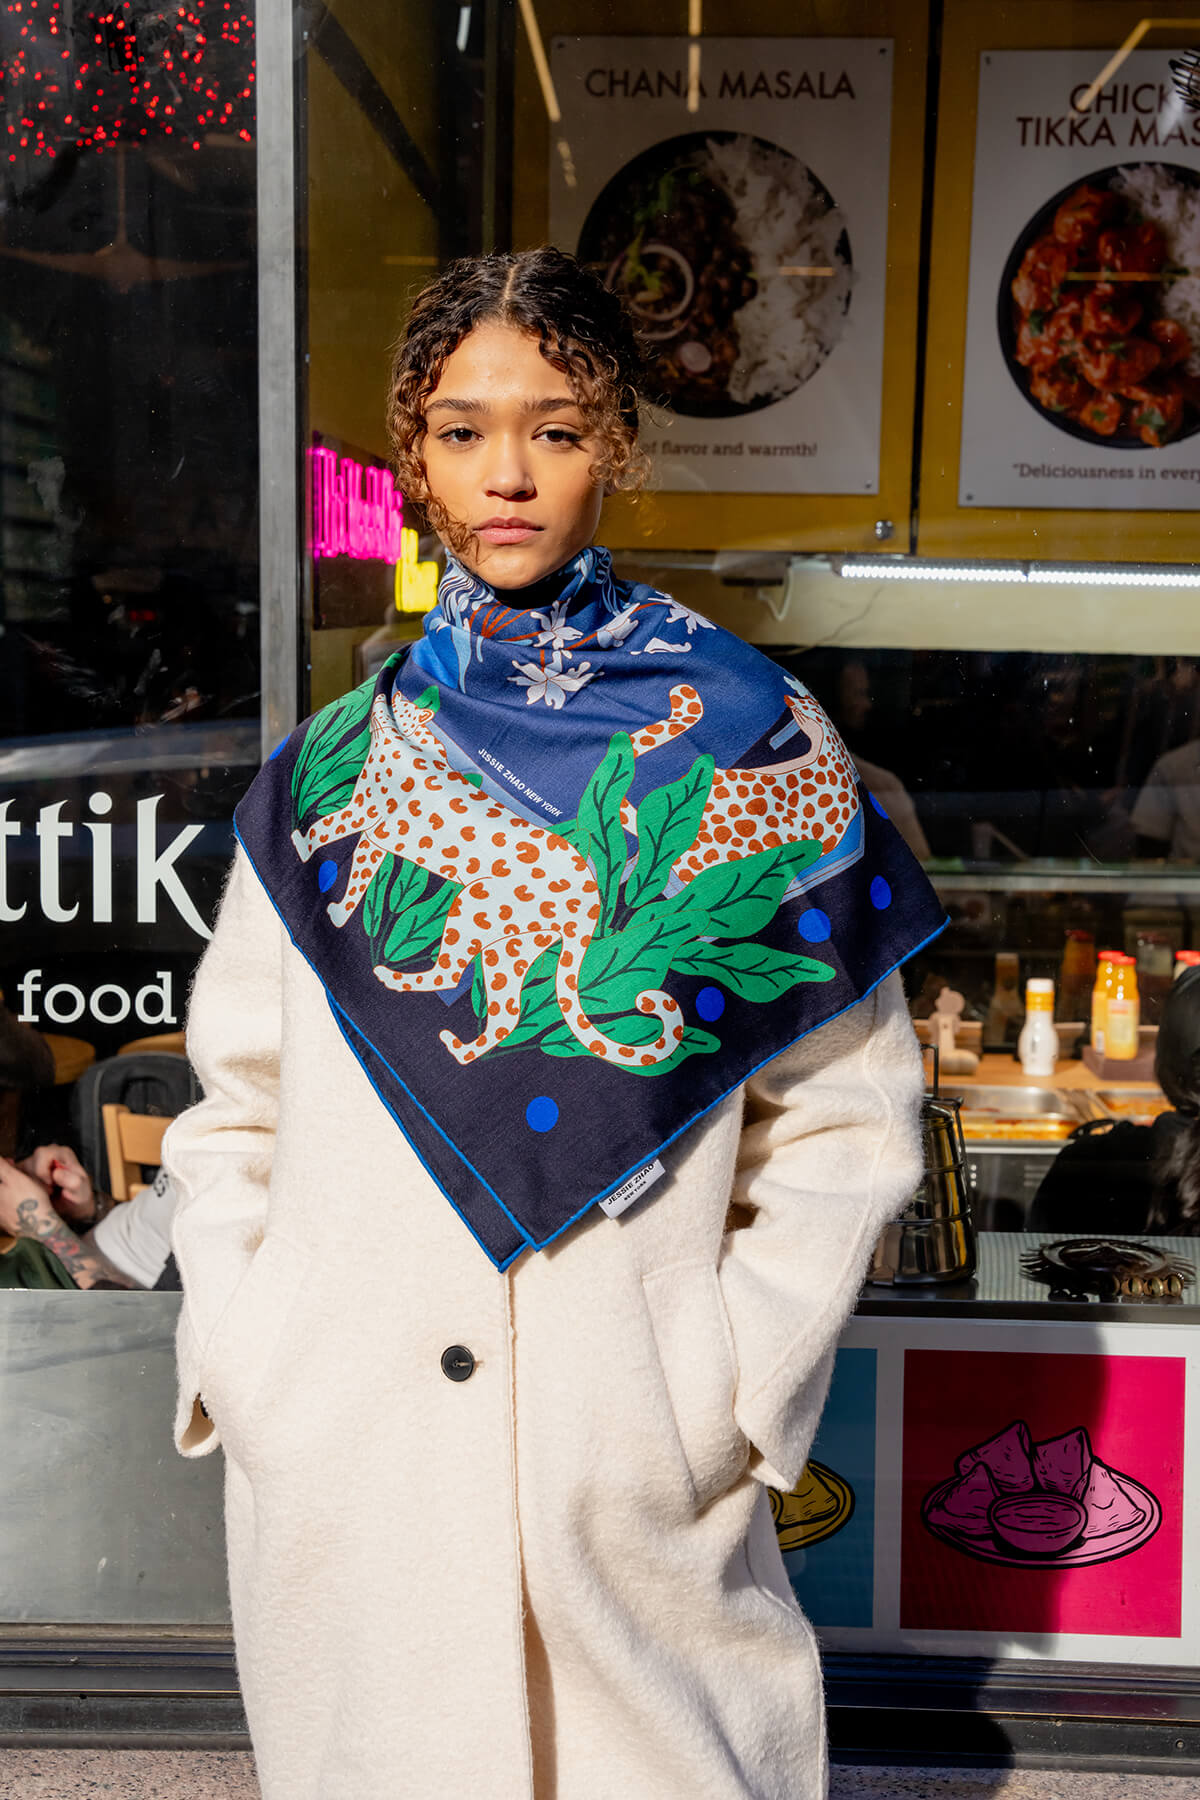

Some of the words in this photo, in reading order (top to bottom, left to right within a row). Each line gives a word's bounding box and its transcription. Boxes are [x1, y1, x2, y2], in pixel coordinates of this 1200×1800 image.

[719, 70, 855, 99] MASALA
[1016, 116, 1116, 146] TIKKA
[661, 440, 708, 456] flavor
[712, 441, 744, 456] and
[1139, 465, 1156, 479] in
[503, 769, 525, 790] ZHAO
[523, 787, 543, 804] NEW
[541, 801, 563, 817] YORK
[17, 969, 177, 1024] food
[608, 1183, 633, 1205] JESSIE
[634, 1163, 654, 1184] ZHAO
